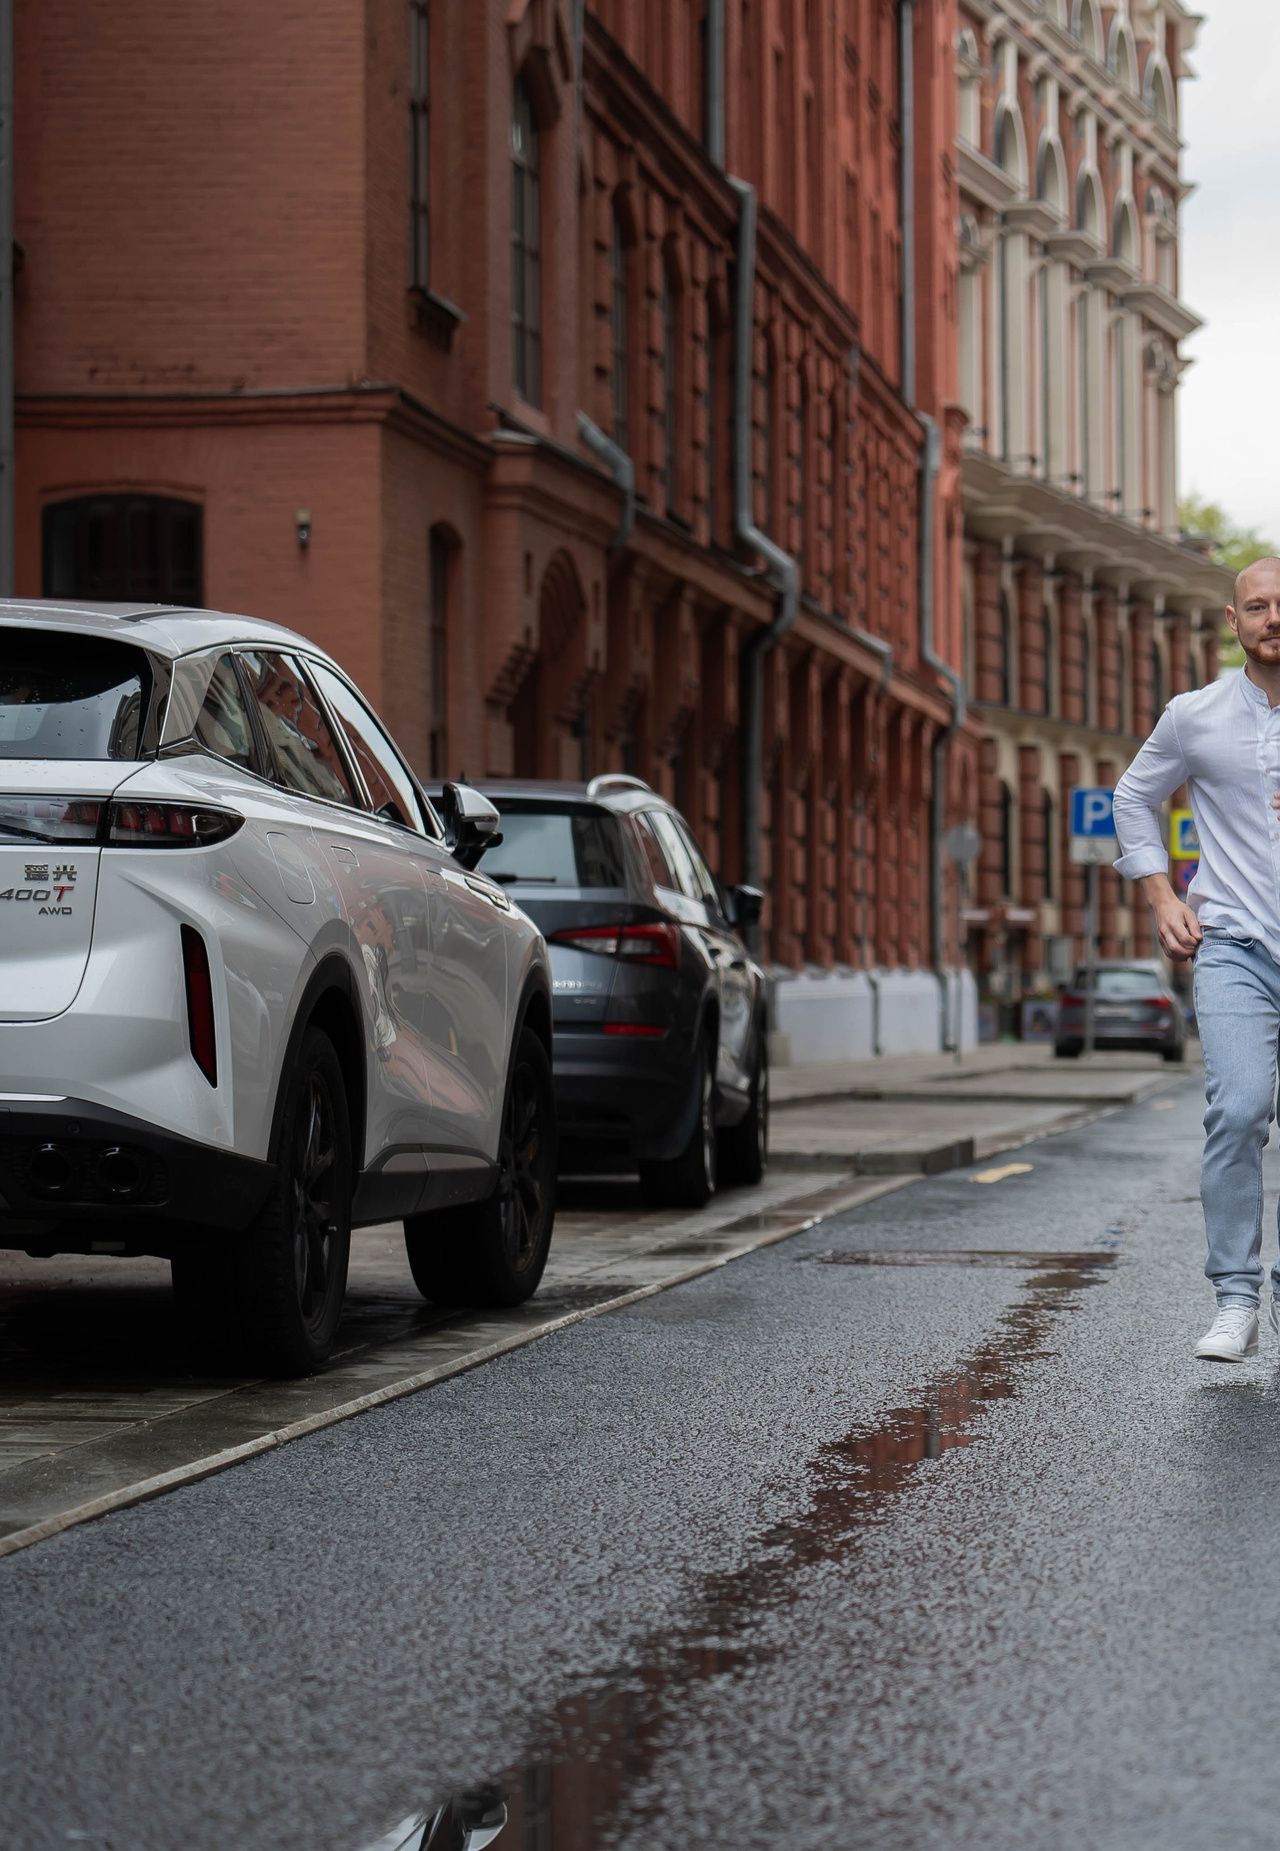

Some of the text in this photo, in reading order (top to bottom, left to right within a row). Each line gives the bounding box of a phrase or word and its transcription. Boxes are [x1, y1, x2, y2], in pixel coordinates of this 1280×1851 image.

[1083, 794, 1112, 834] P
[0, 885, 75, 902] 400T
[38, 906, 73, 915] AWD
